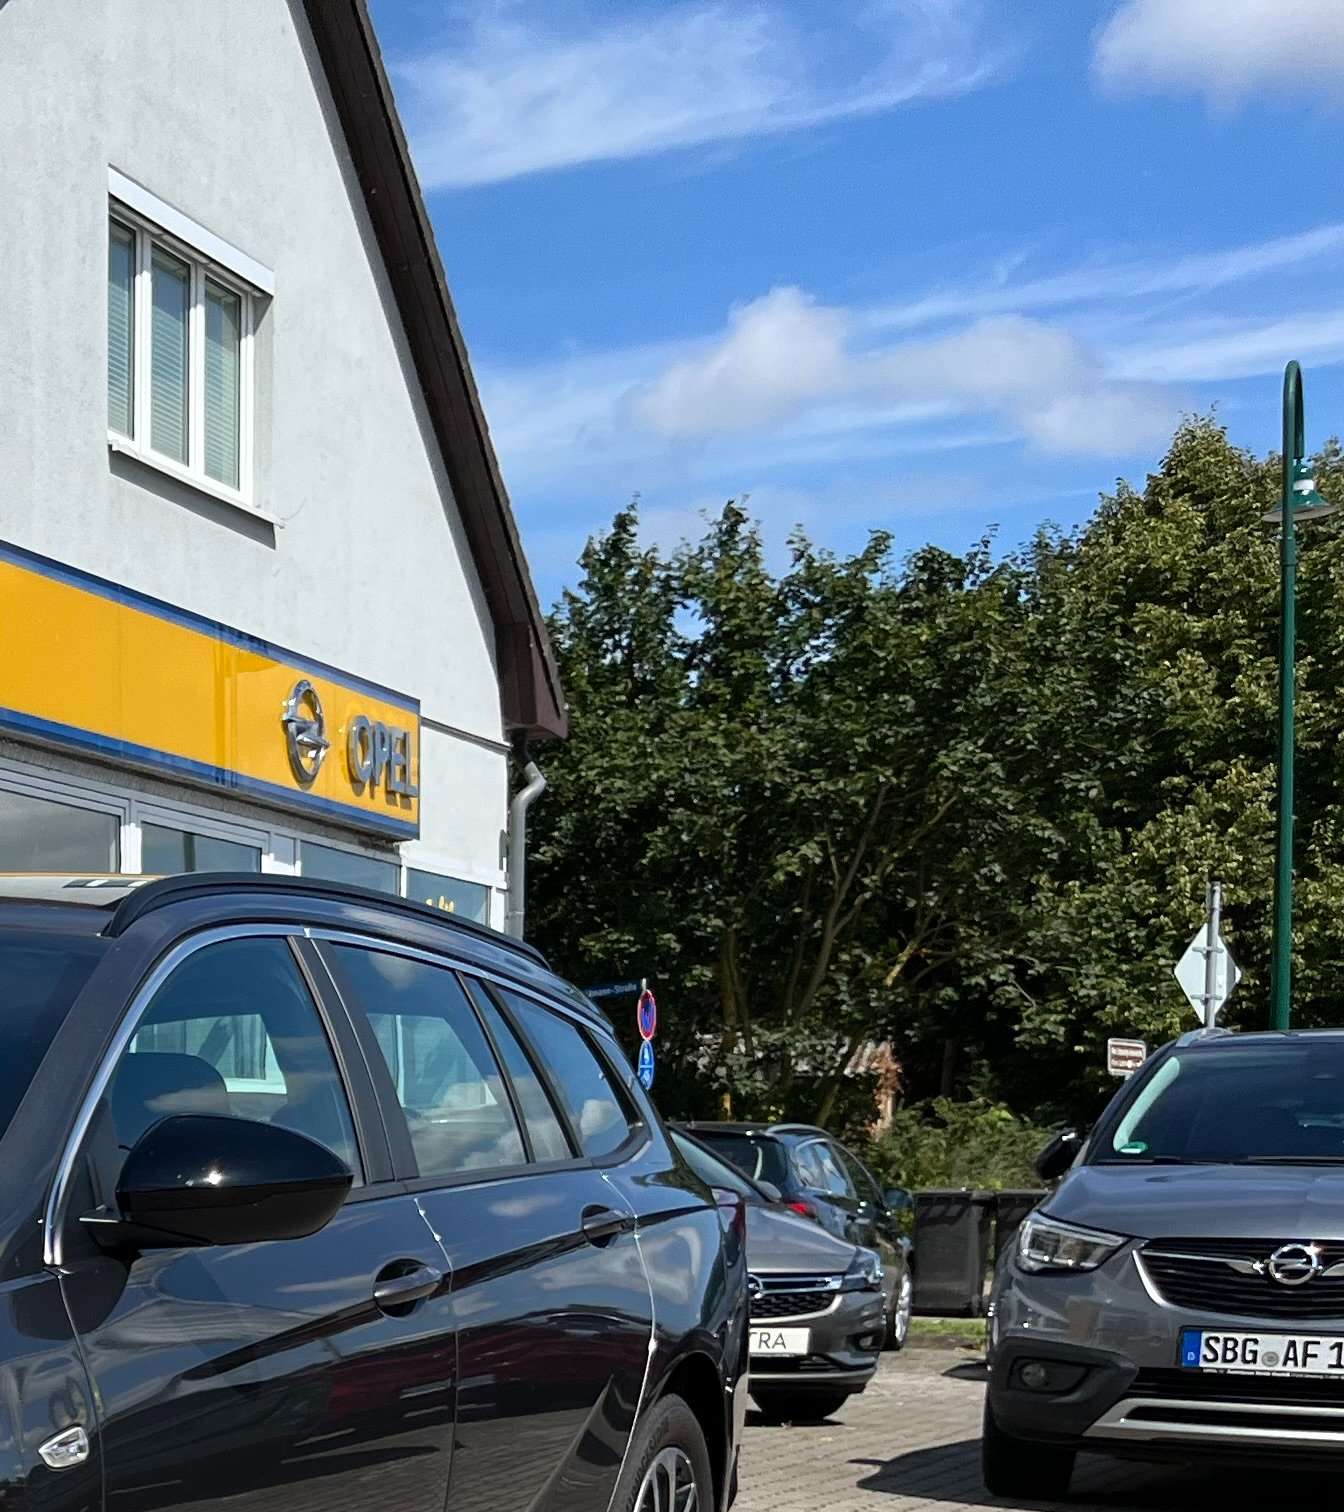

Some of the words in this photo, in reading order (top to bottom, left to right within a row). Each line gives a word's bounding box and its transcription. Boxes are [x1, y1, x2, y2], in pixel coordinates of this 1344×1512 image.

[346, 715, 417, 797] OPEL
[1202, 1336, 1259, 1365] SBG
[1282, 1340, 1321, 1368] AF
